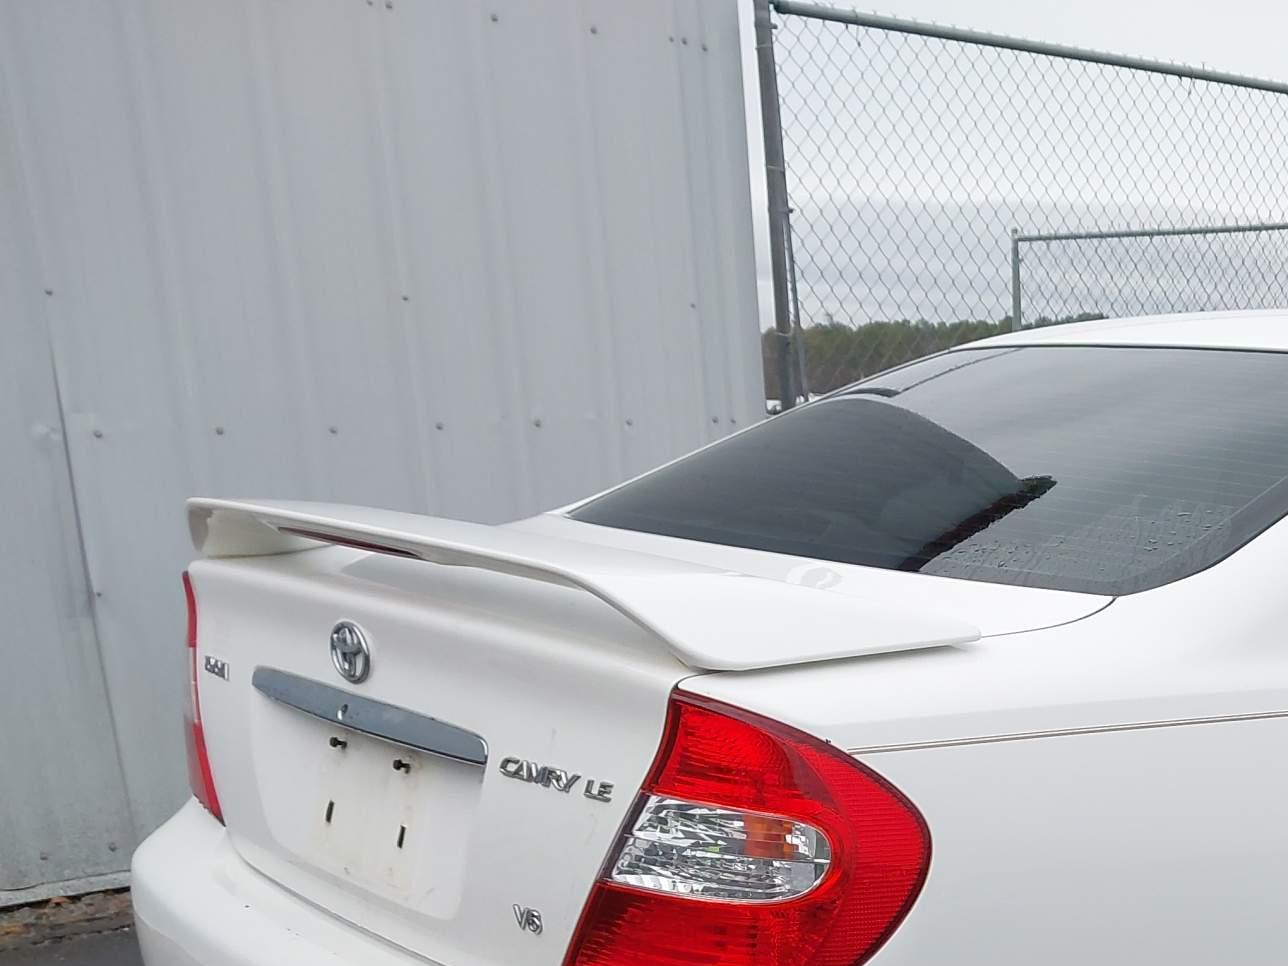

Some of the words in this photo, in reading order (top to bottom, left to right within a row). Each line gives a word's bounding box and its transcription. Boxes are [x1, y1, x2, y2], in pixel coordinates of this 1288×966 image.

[499, 757, 581, 793] CAMRY
[584, 779, 614, 803] LE
[513, 904, 543, 935] V6
